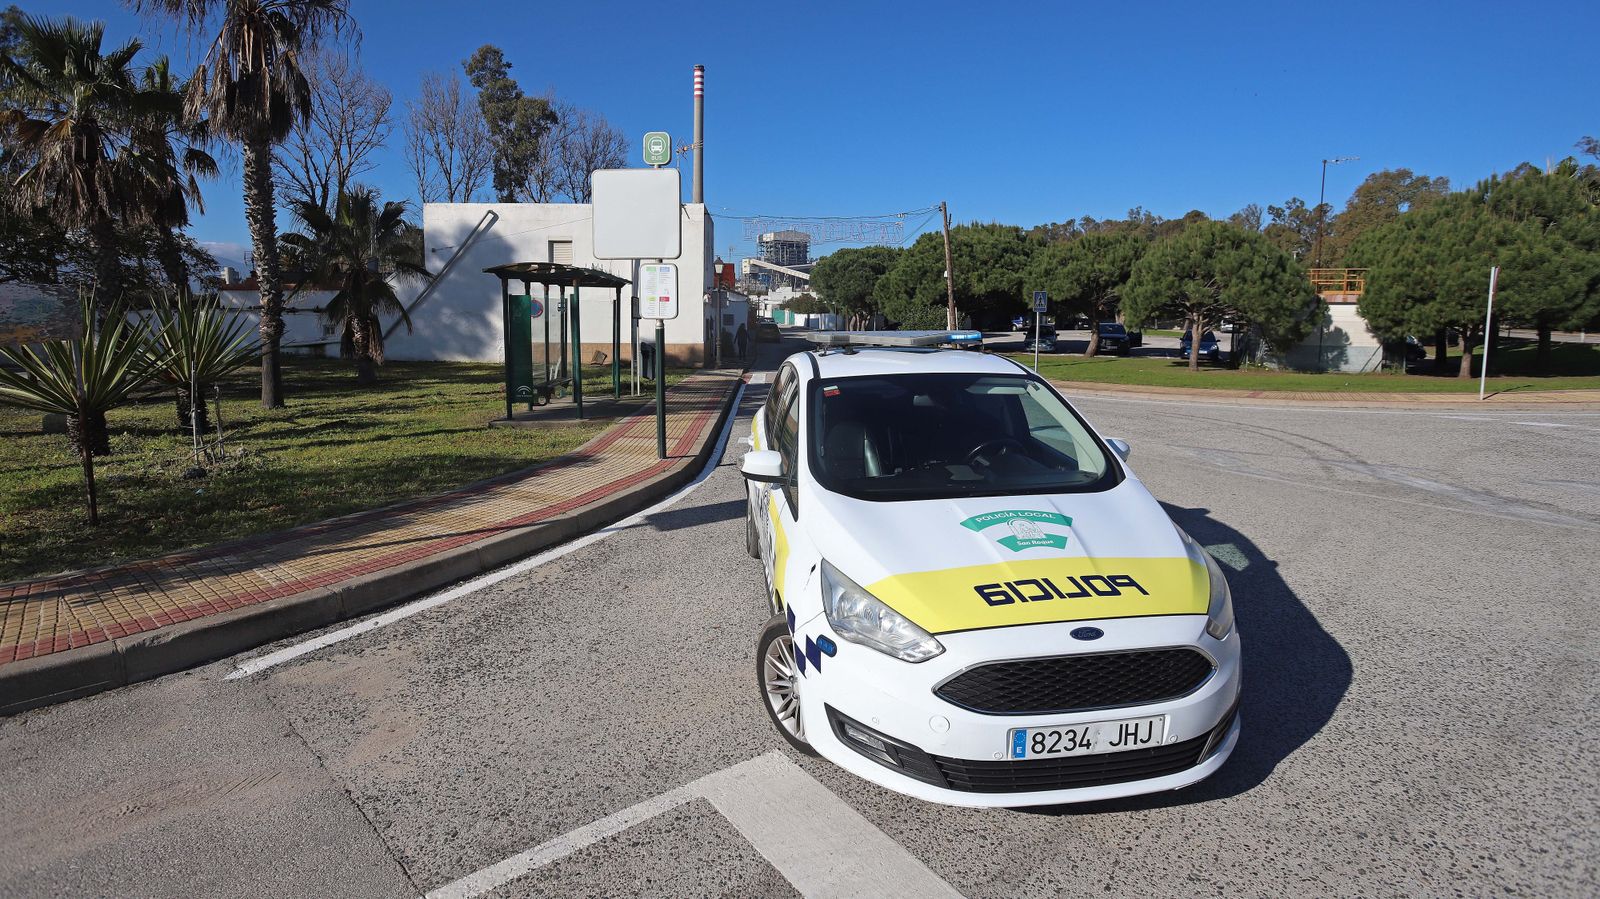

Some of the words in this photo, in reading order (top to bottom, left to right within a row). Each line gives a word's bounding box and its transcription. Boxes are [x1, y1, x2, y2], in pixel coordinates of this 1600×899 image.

[1019, 511, 1056, 519] LOCAL
[1031, 727, 1091, 754] 8234
[1109, 720, 1153, 747] JHJ
[1016, 746, 1022, 754] E
